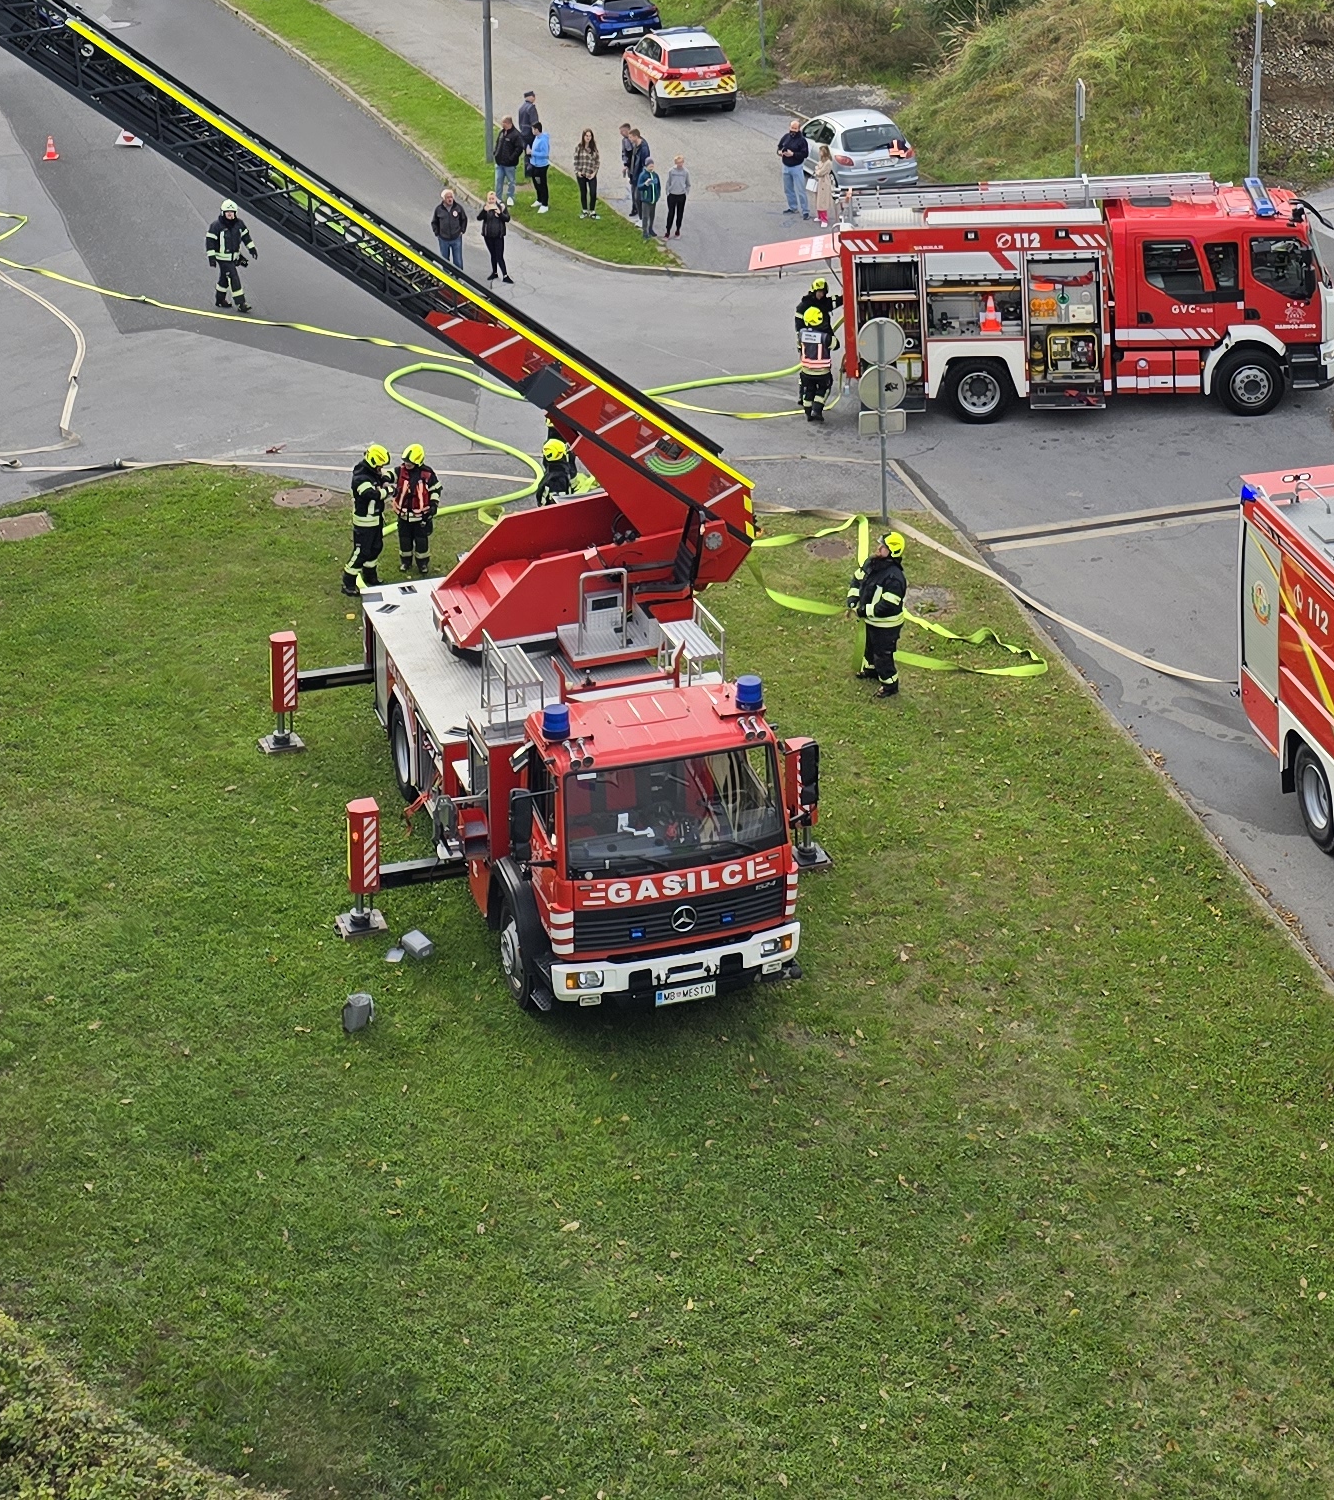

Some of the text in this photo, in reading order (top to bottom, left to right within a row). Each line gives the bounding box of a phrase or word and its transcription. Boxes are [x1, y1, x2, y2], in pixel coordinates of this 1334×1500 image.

[1014, 233, 1040, 248] 112
[1171, 305, 1196, 314] GVC
[1308, 596, 1329, 636] 112
[607, 859, 755, 904] GASILCI
[664, 991, 676, 1001] MB
